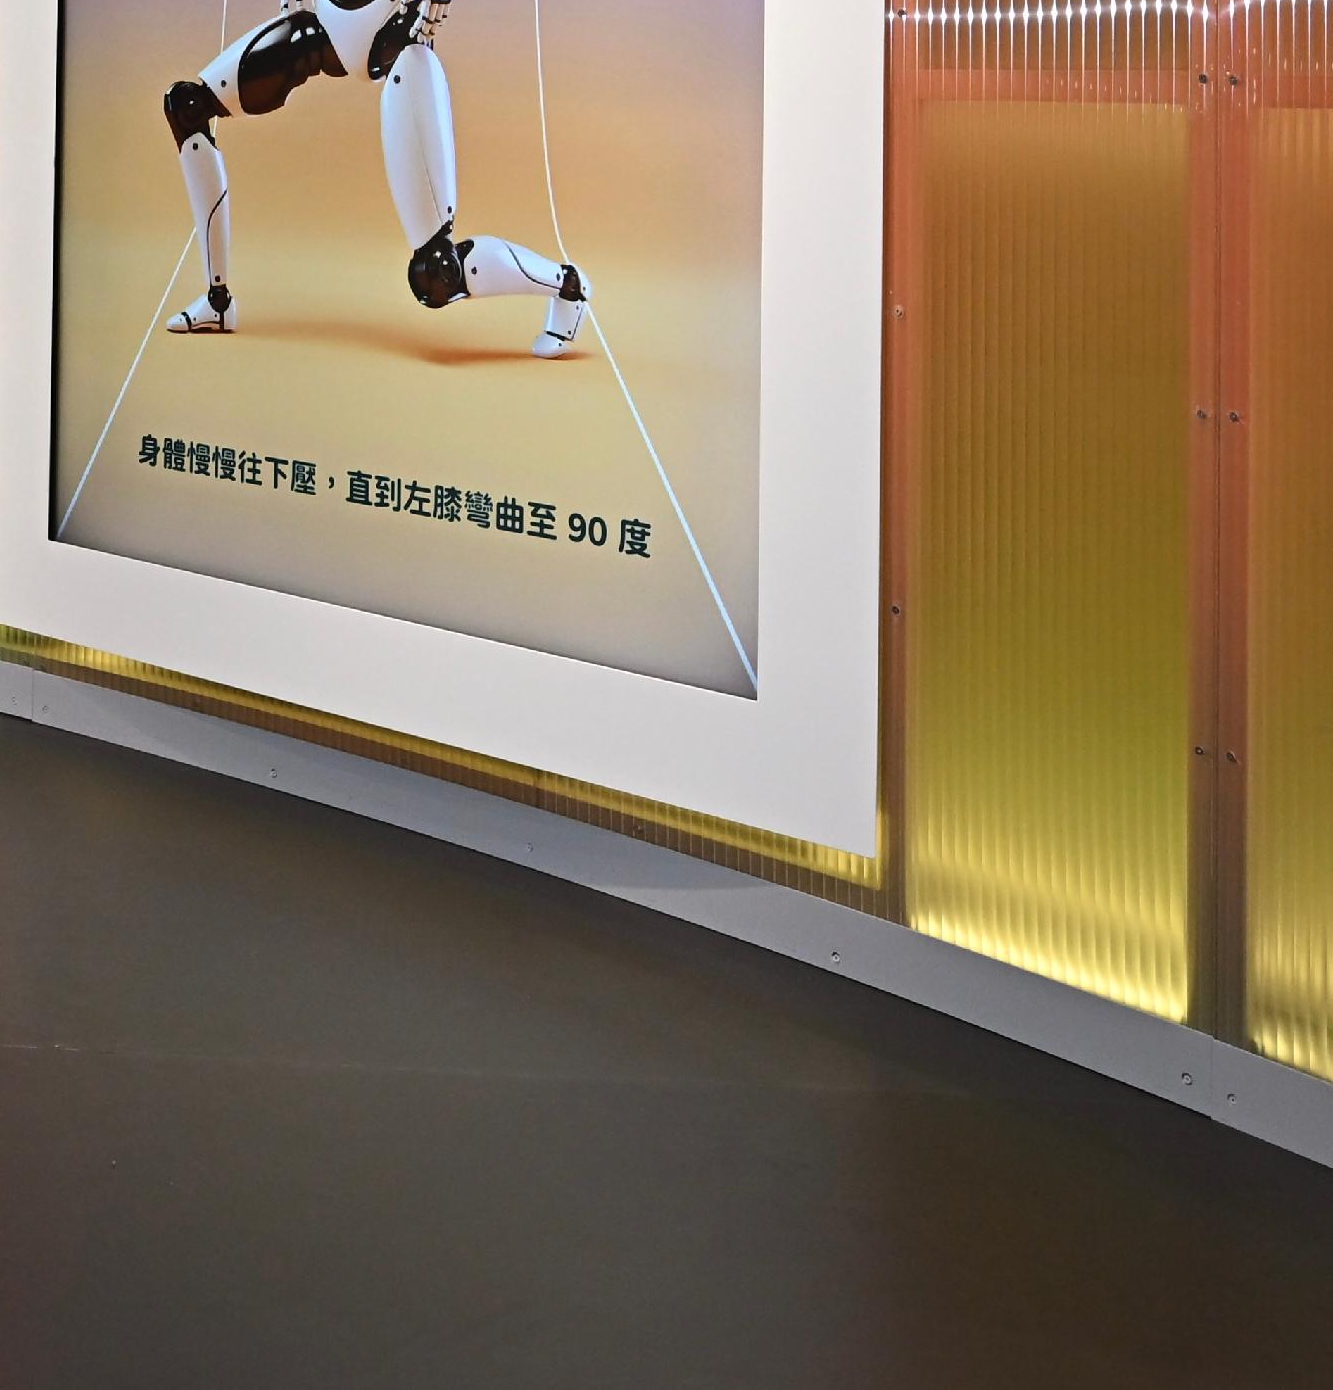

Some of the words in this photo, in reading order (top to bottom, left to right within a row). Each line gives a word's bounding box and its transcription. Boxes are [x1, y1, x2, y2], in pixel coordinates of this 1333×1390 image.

[138, 433, 558, 541] 身體慢慢往下壓，直到左膝彎曲至
[568, 513, 608, 547] 90
[618, 518, 651, 558] 度
